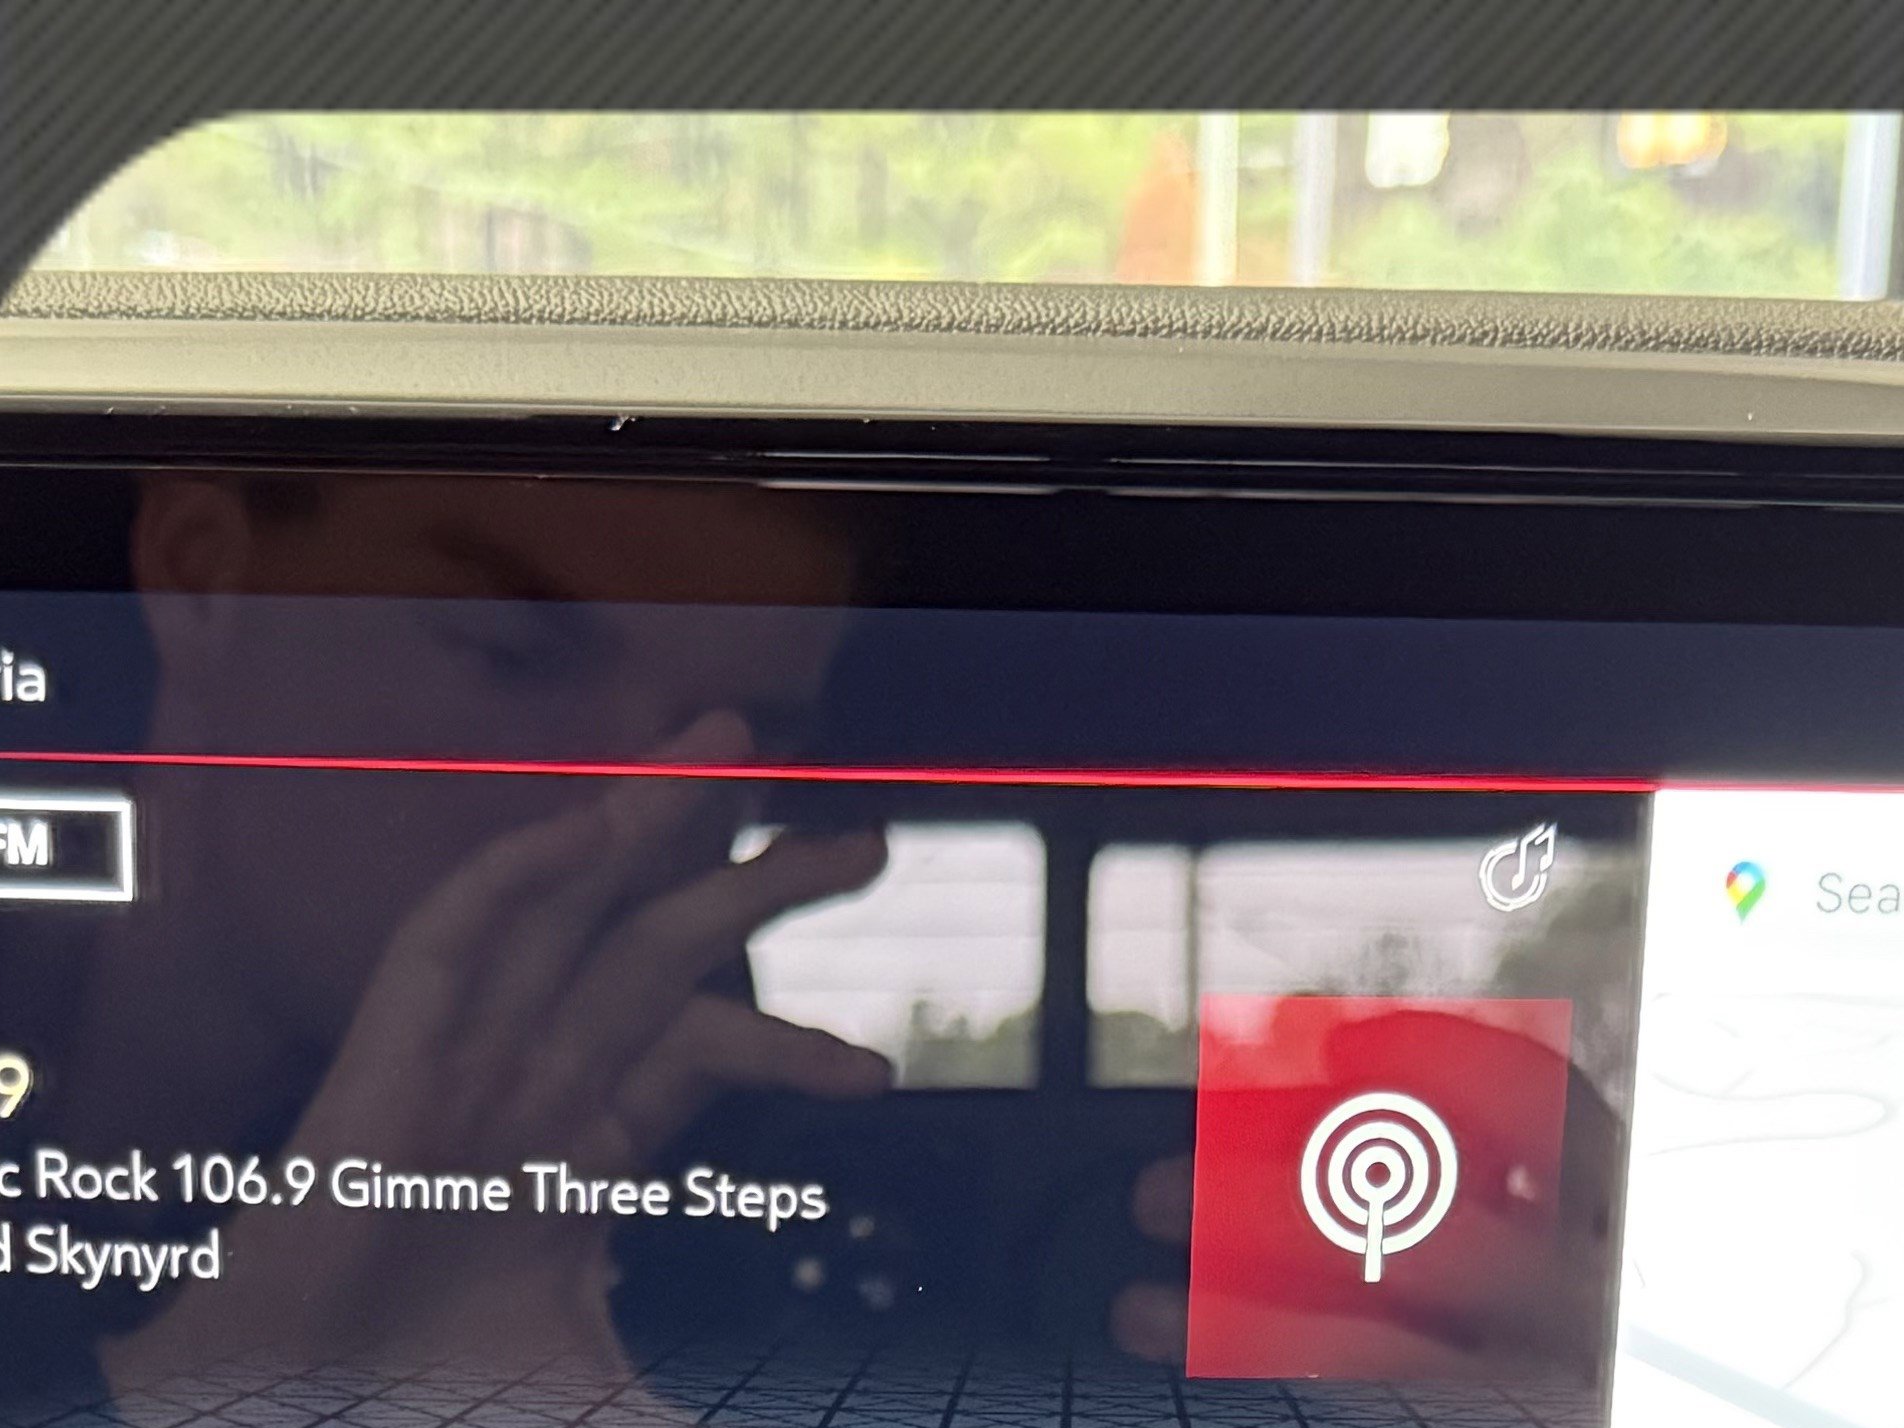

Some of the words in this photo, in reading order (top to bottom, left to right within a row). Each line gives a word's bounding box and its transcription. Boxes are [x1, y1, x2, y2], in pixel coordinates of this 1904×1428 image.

[35, 1148, 158, 1201] Rock
[173, 1153, 315, 1205] 106.9
[330, 1158, 511, 1211] Gimme
[521, 1162, 671, 1215] Three
[683, 1167, 830, 1230] Steps
[26, 1224, 220, 1290] Skynyrd
